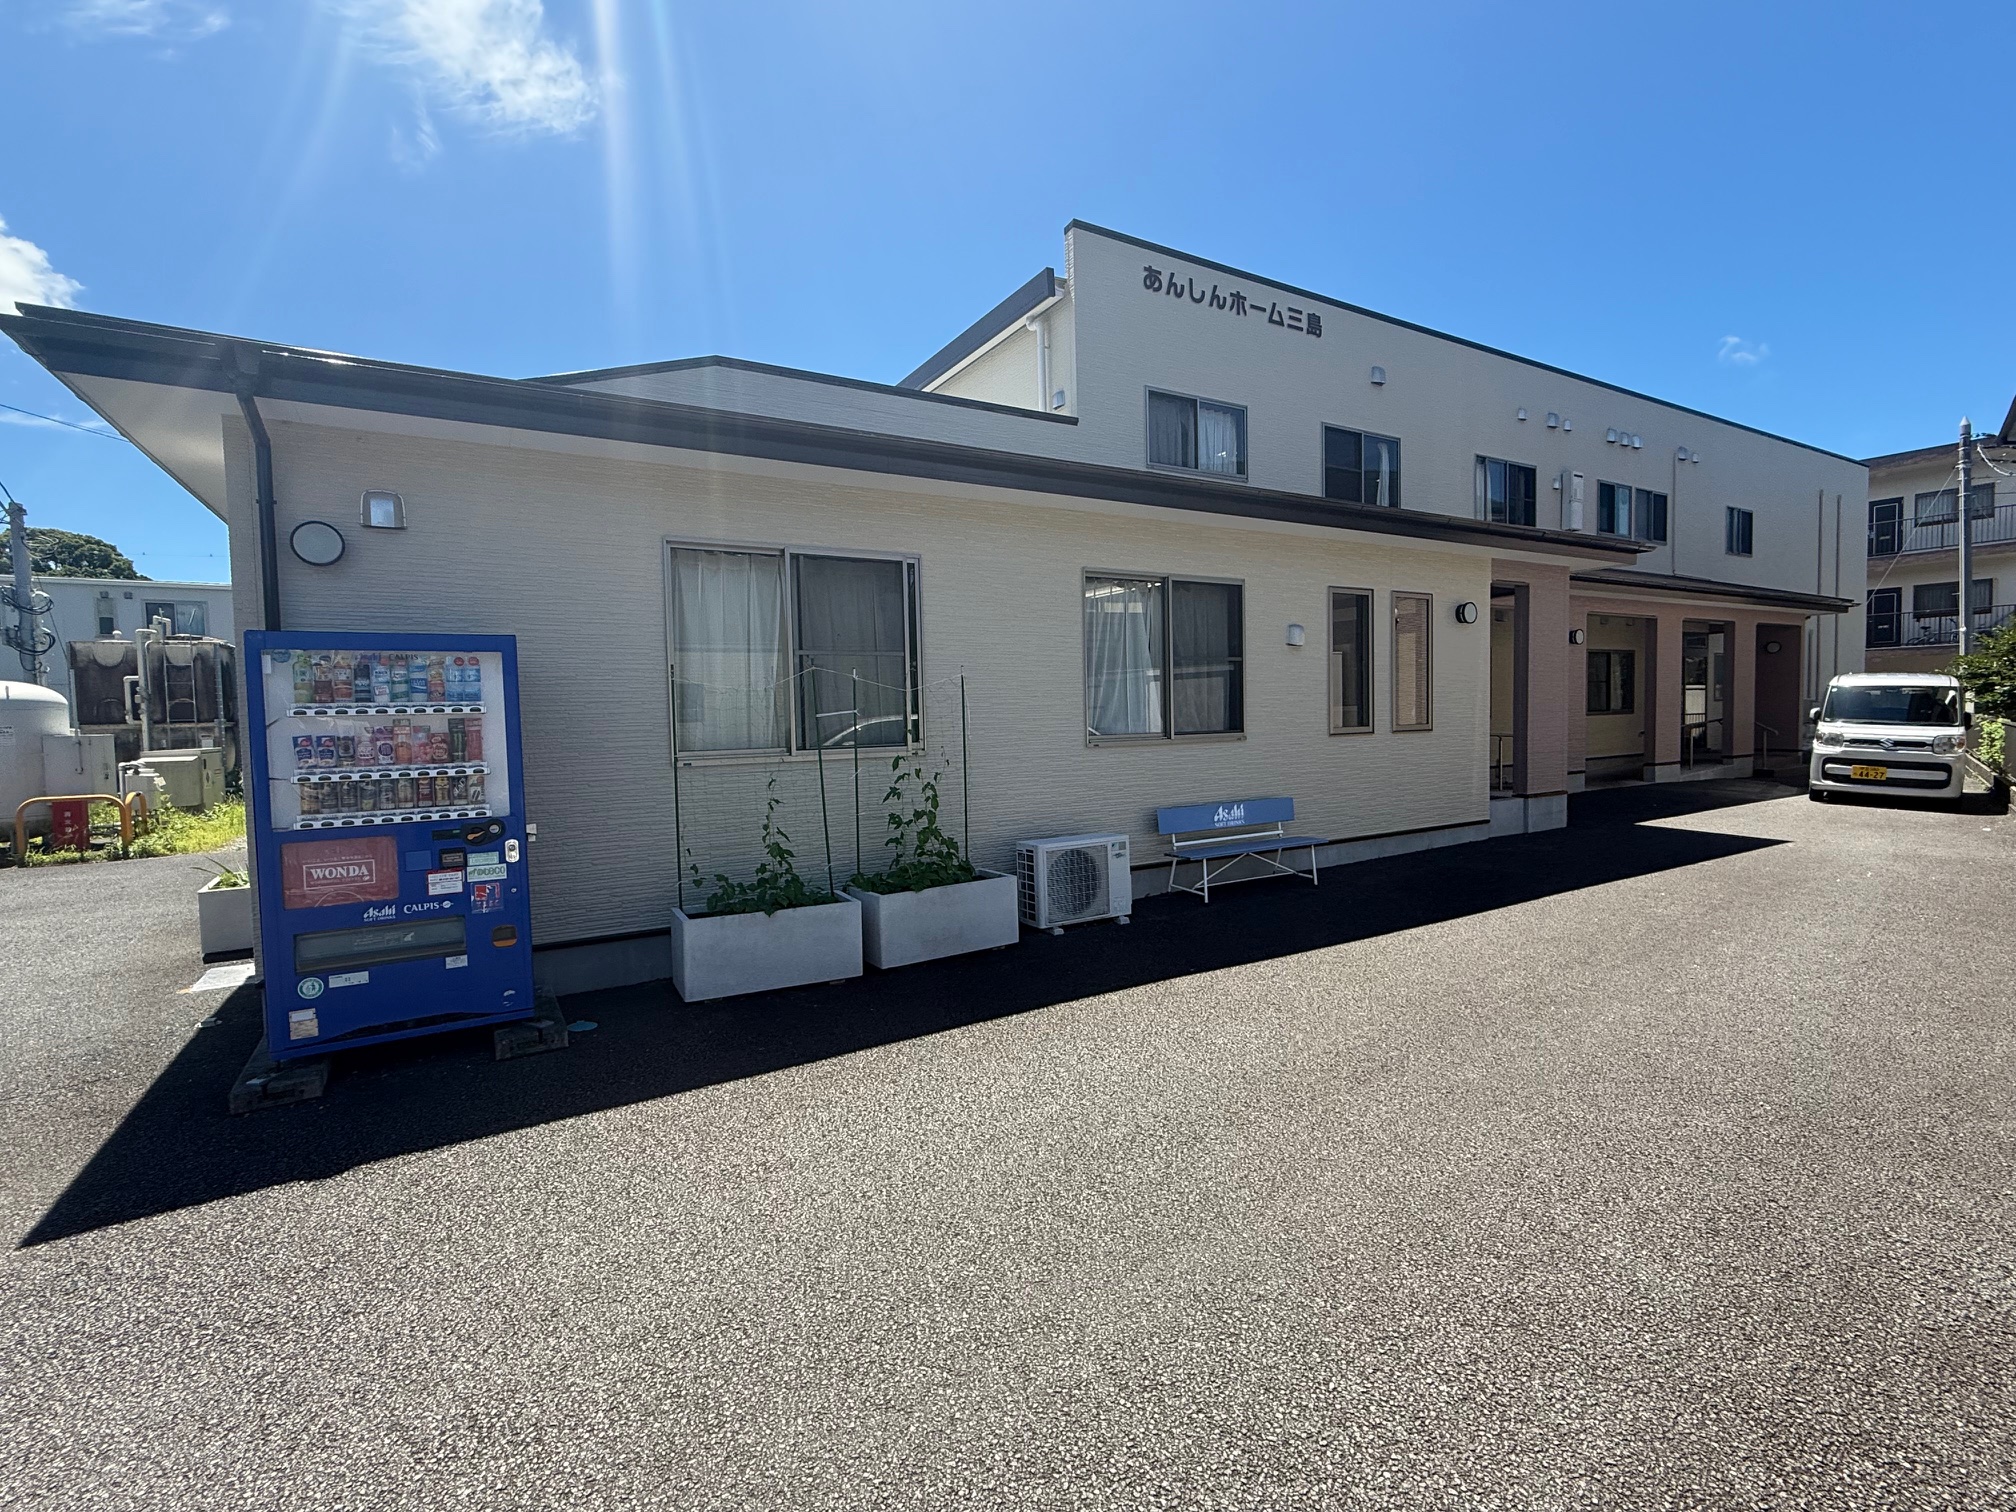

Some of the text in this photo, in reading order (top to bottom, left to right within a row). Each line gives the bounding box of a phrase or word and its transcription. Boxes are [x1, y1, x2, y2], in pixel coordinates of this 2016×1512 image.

[1143, 265, 1323, 338] あんしんホーム三島
[1859, 771, 1885, 779] 44-27
[1214, 804, 1244, 821] Asahi
[310, 865, 369, 879] WONDA
[363, 904, 396, 918] Asahi
[404, 902, 439, 914] CALPIS
